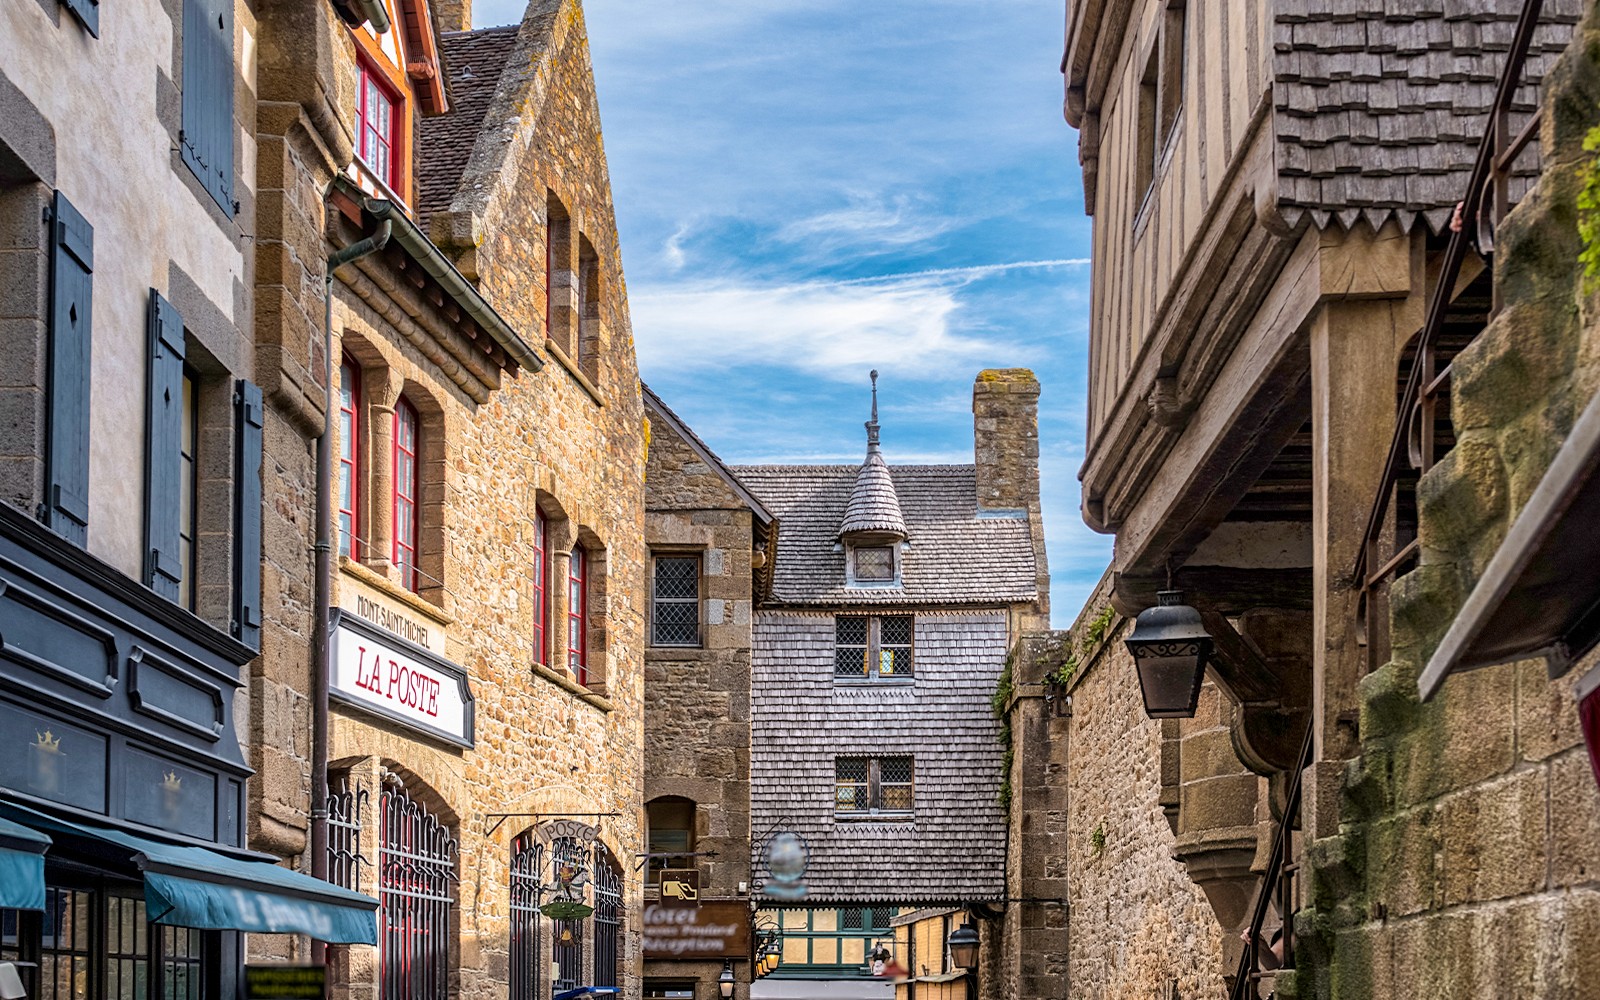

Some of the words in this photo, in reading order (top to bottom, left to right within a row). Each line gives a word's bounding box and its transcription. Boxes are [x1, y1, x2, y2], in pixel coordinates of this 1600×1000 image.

[355, 646, 382, 695] LA
[386, 660, 440, 717] POSTE
[544, 821, 595, 841] POSTE
